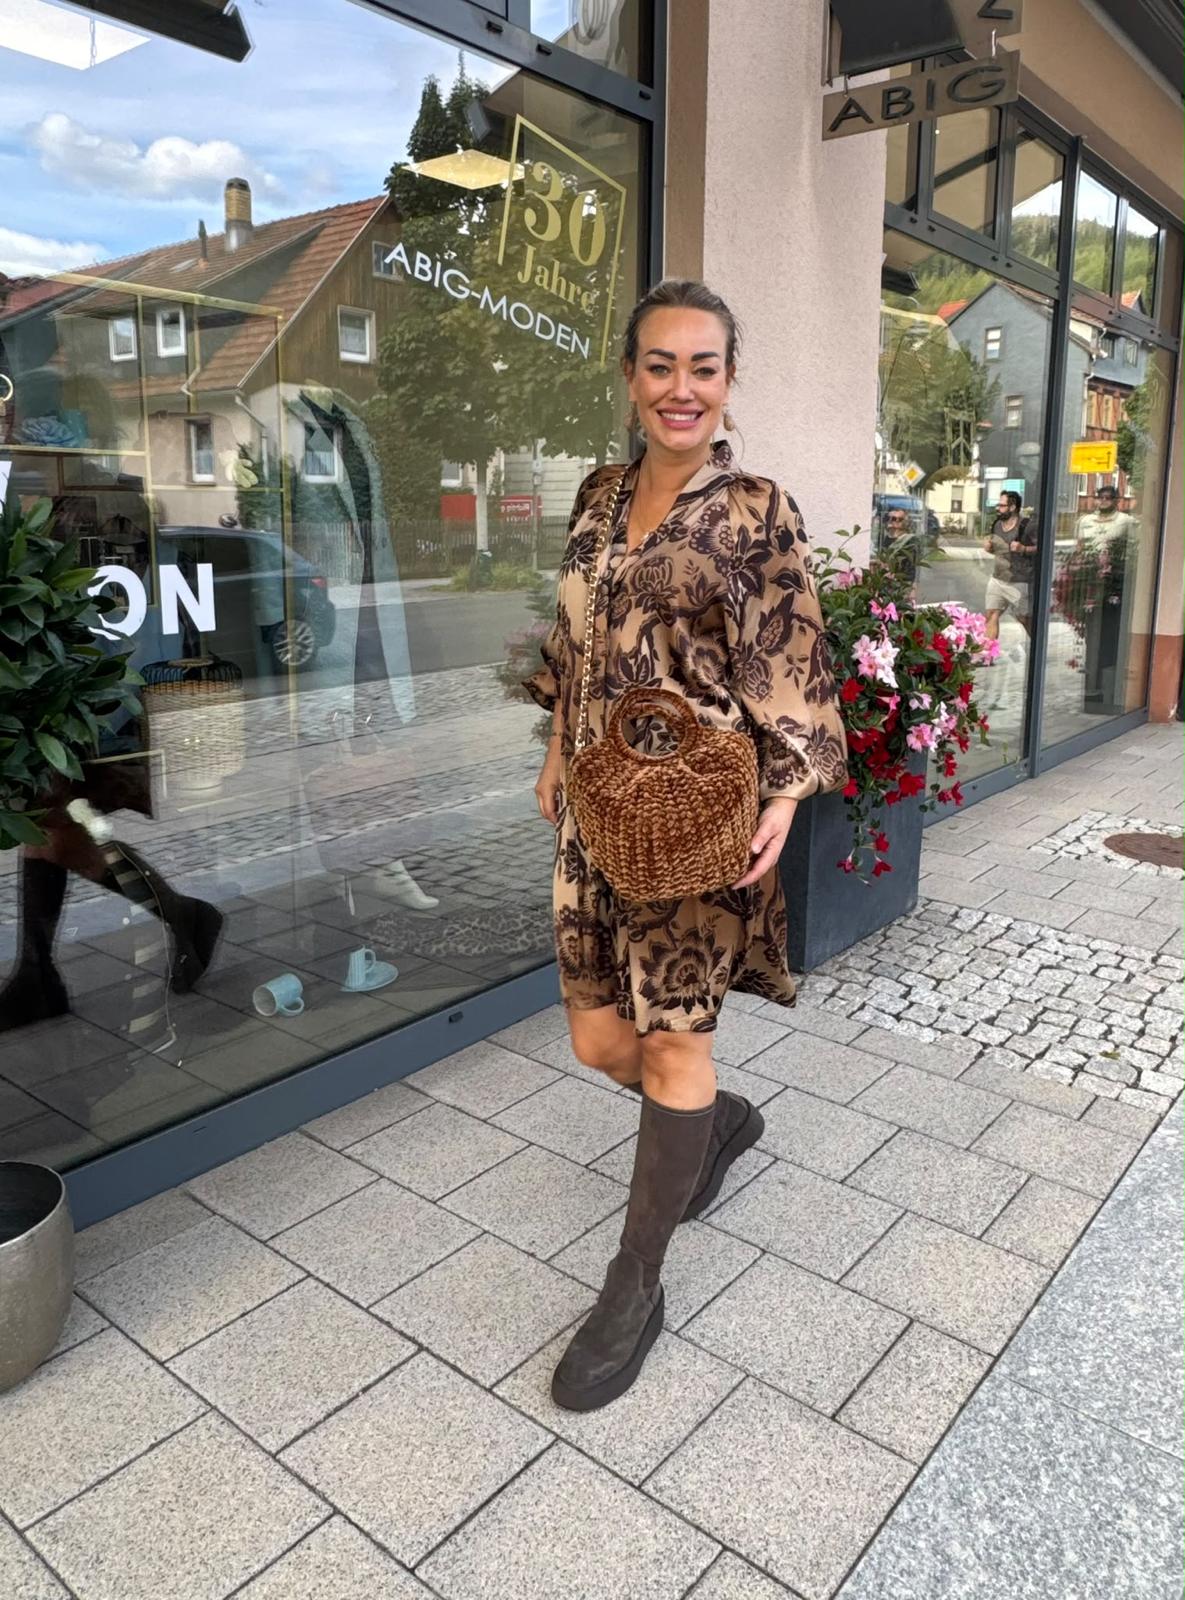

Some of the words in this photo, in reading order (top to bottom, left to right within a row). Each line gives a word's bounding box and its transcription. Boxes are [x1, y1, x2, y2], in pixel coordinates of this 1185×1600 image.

[828, 65, 1006, 132] ABIG
[524, 162, 606, 266] 30
[384, 242, 590, 359] ABIG-MODEN
[518, 243, 597, 313] Jahre
